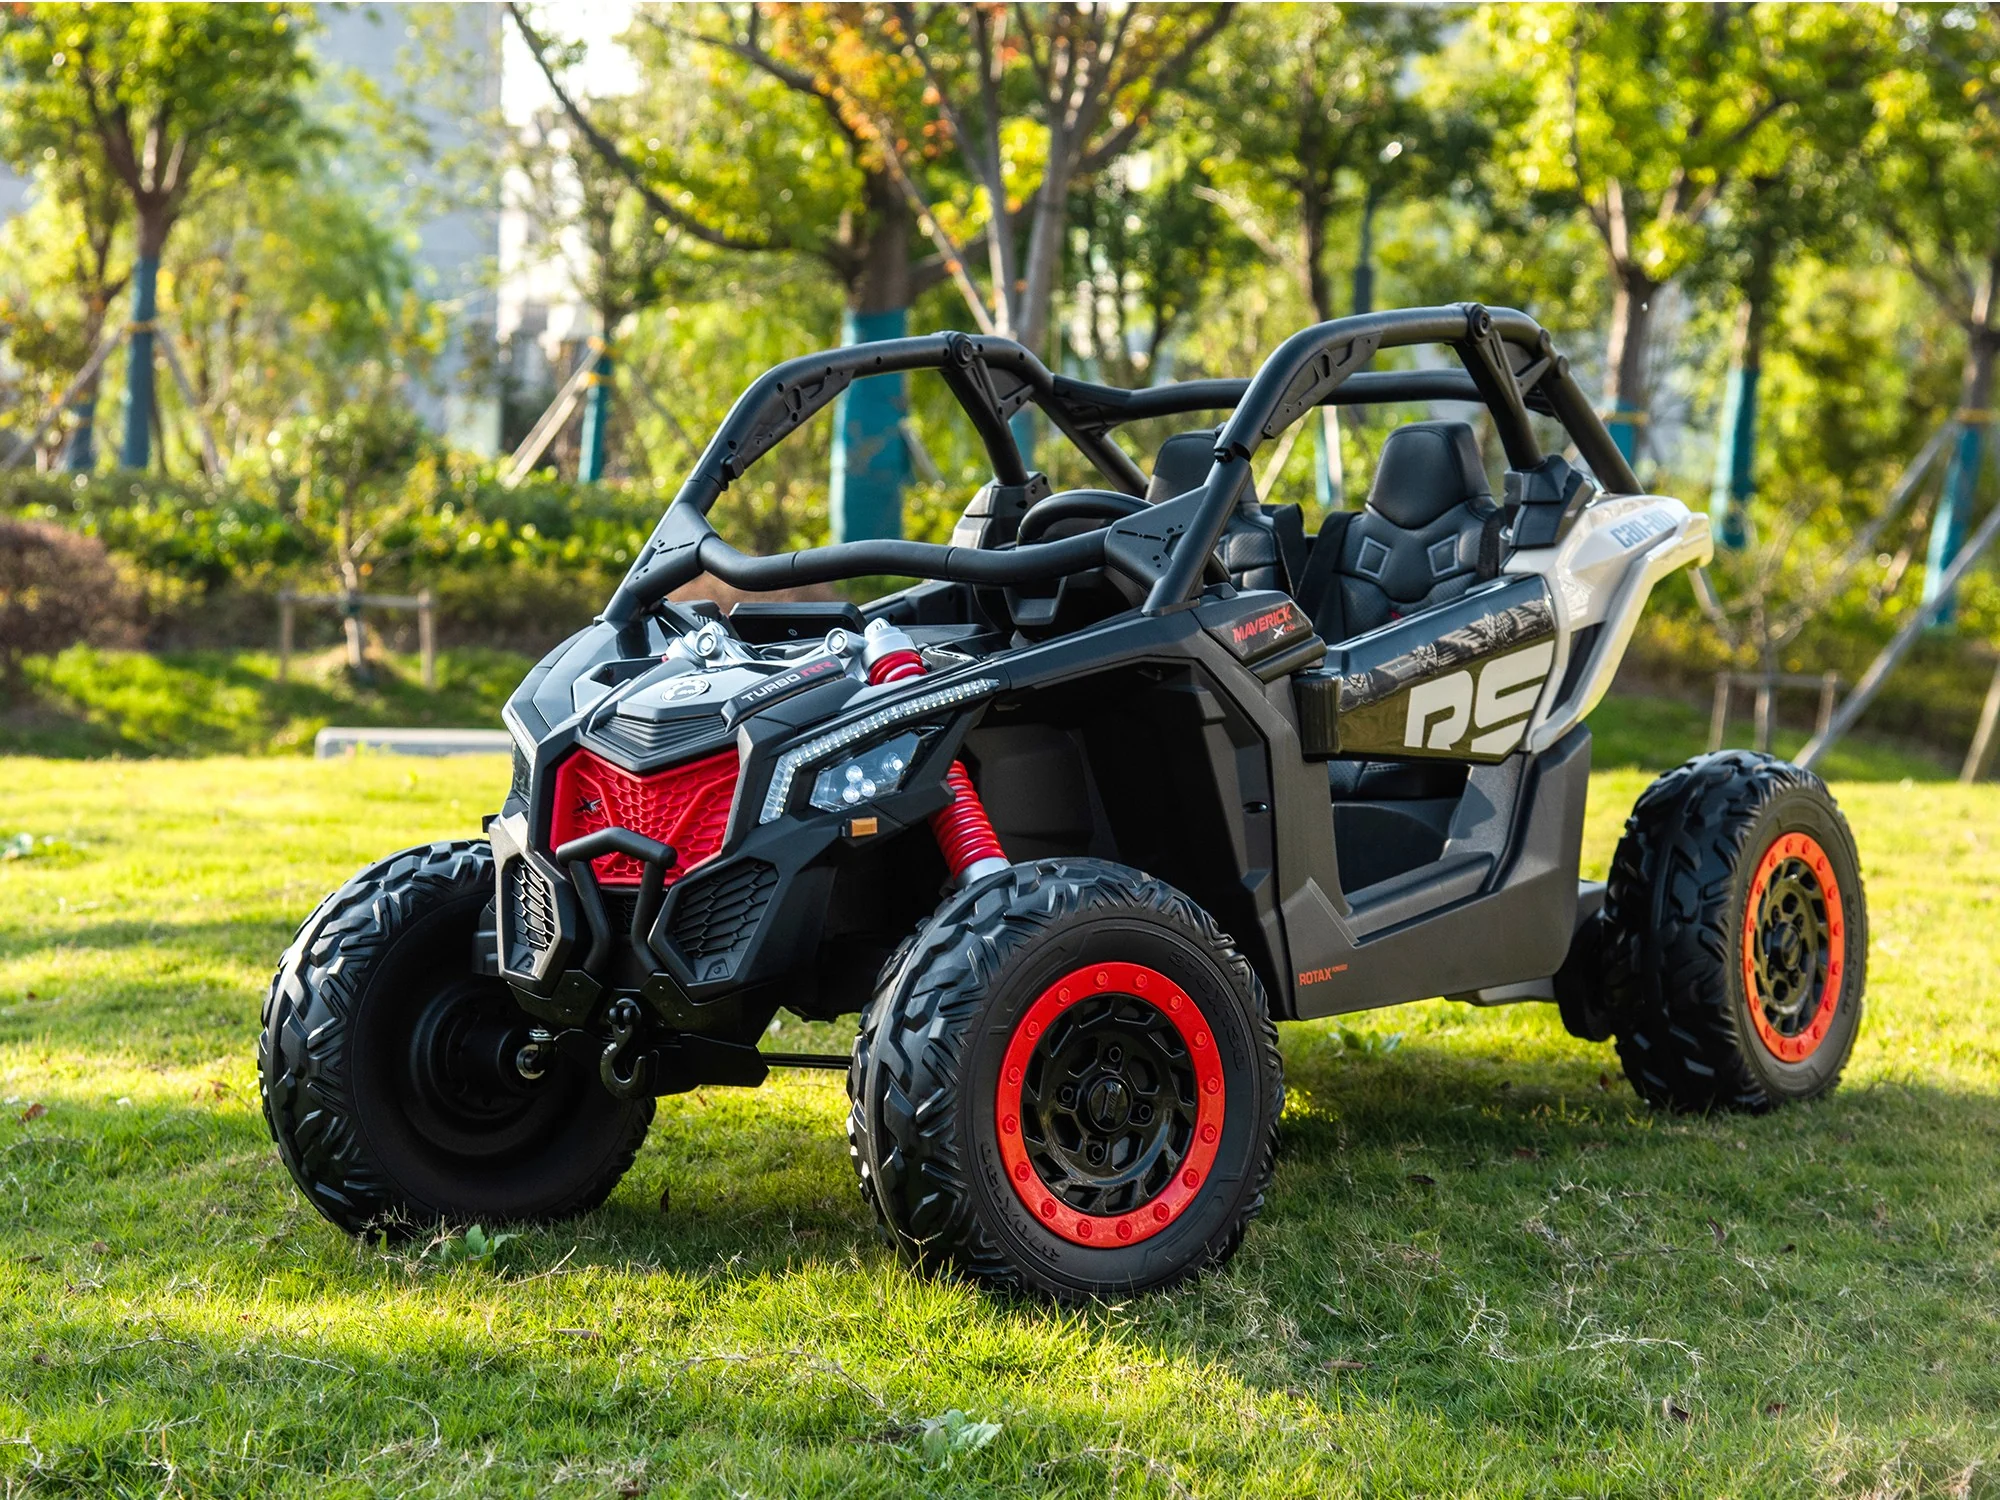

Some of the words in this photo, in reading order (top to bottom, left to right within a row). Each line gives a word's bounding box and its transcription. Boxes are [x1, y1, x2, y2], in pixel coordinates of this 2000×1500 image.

[1232, 605, 1293, 643] MAVERICK
[741, 674, 801, 702] TURBO
[800, 661, 836, 677] RR
[1404, 640, 1555, 755] RS
[1299, 967, 1332, 986] ROTAX
